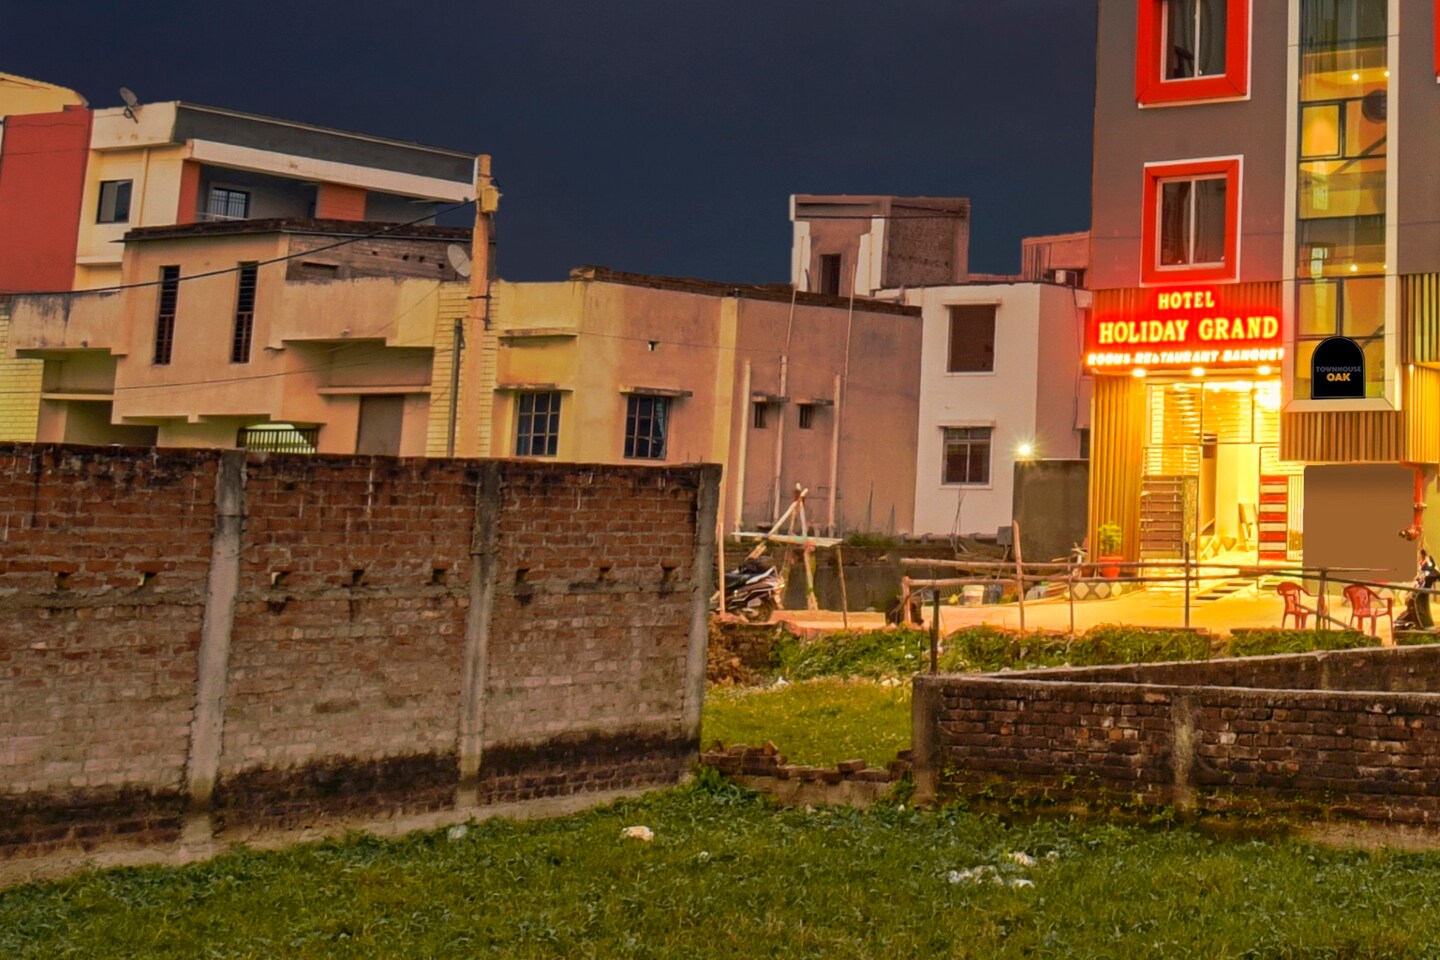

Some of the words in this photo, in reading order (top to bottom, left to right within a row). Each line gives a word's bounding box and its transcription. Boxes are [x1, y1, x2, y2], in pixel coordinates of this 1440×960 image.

[1158, 291, 1215, 309] HOTEL
[1099, 320, 1189, 344] HOLIDAY
[1199, 316, 1279, 340] GRAND
[1326, 372, 1351, 382] OAK
